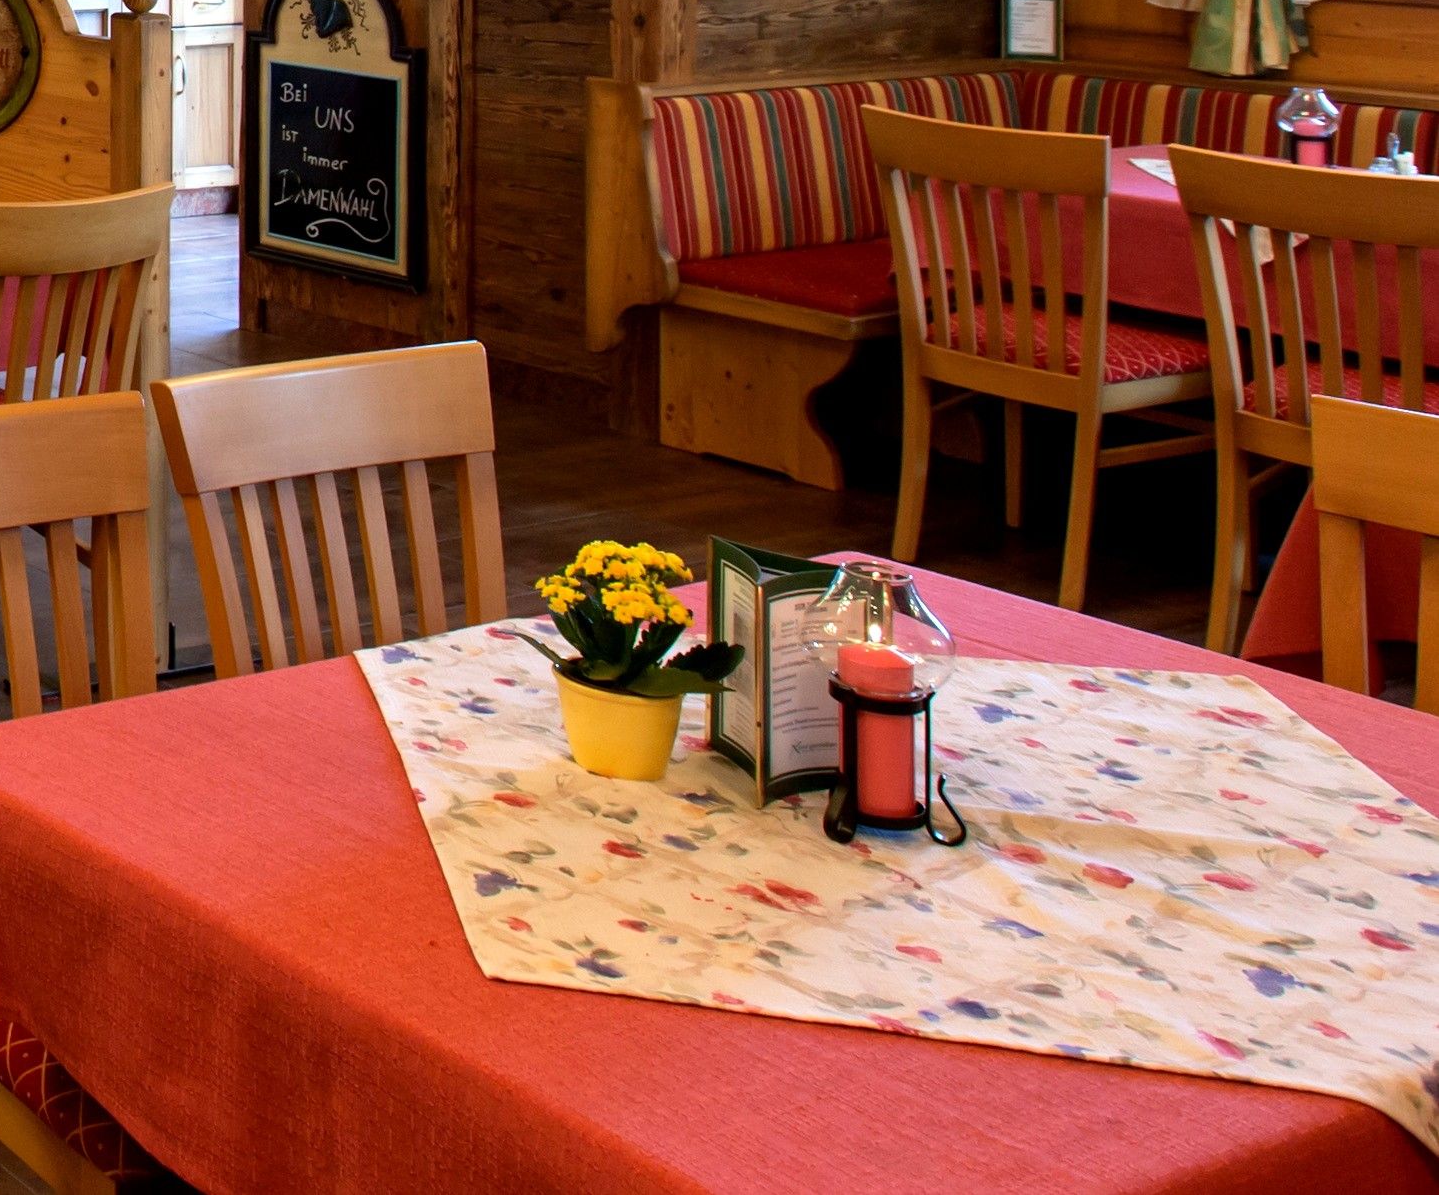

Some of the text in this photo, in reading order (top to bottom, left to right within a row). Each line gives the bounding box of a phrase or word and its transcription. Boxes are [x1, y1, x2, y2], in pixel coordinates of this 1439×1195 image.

[314, 106, 355, 133] UNS
[302, 146, 348, 170] immer
[273, 168, 379, 222] DAMENWAHL
